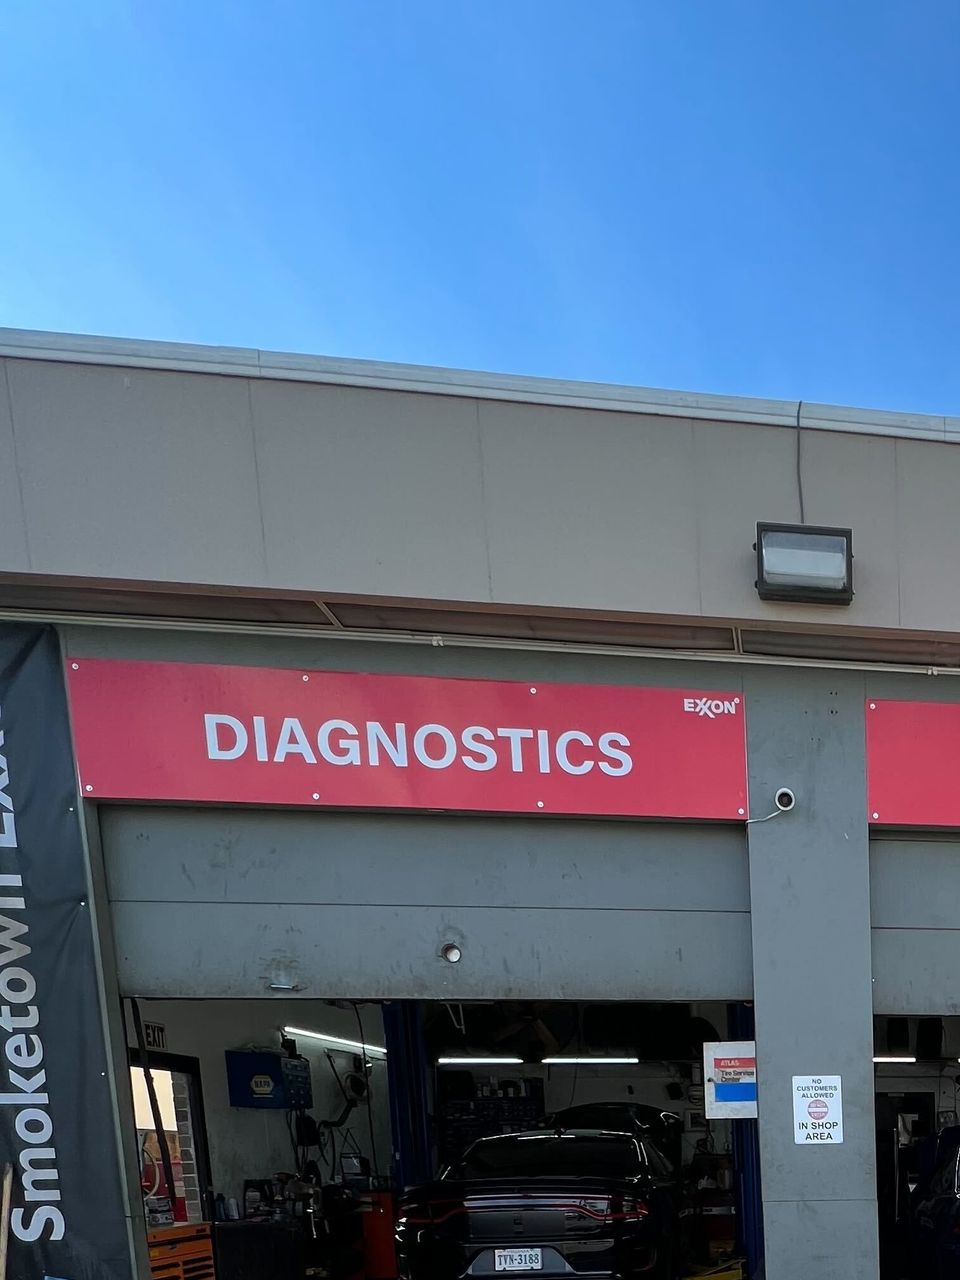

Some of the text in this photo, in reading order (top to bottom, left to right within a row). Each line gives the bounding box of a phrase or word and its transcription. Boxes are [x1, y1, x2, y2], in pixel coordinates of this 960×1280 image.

[683, 697, 736, 718] EXXON
[203, 712, 634, 777] DIAGNOSTICS
[145, 1023, 165, 1049] EXIT
[254, 1079, 271, 1088] NAPA
[798, 1121, 838, 1130] IN SHOP
[805, 1132, 833, 1140] AREA
[497, 1253, 540, 1266] TVN-3188
